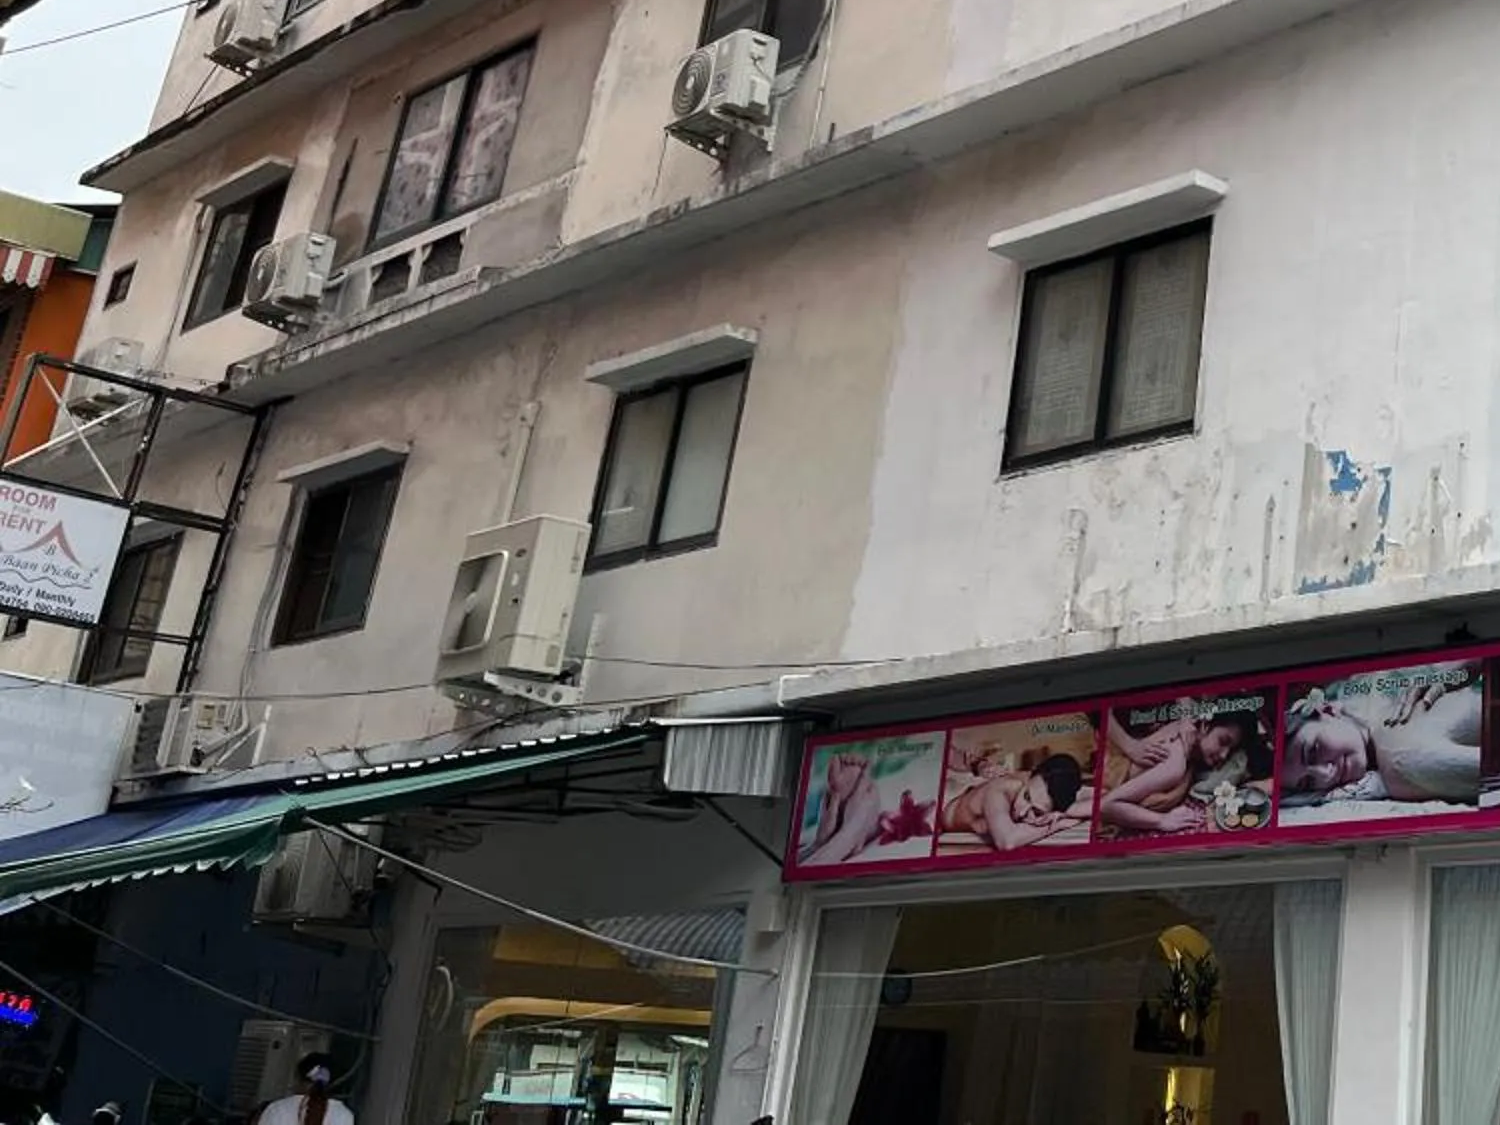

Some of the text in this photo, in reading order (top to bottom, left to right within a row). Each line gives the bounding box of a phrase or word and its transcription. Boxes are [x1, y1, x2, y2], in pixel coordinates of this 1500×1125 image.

[0, 485, 57, 511] ROOM
[36, 588, 76, 607] Monthly
[1342, 680, 1373, 696] Body
[1376, 677, 1410, 692] Scrub
